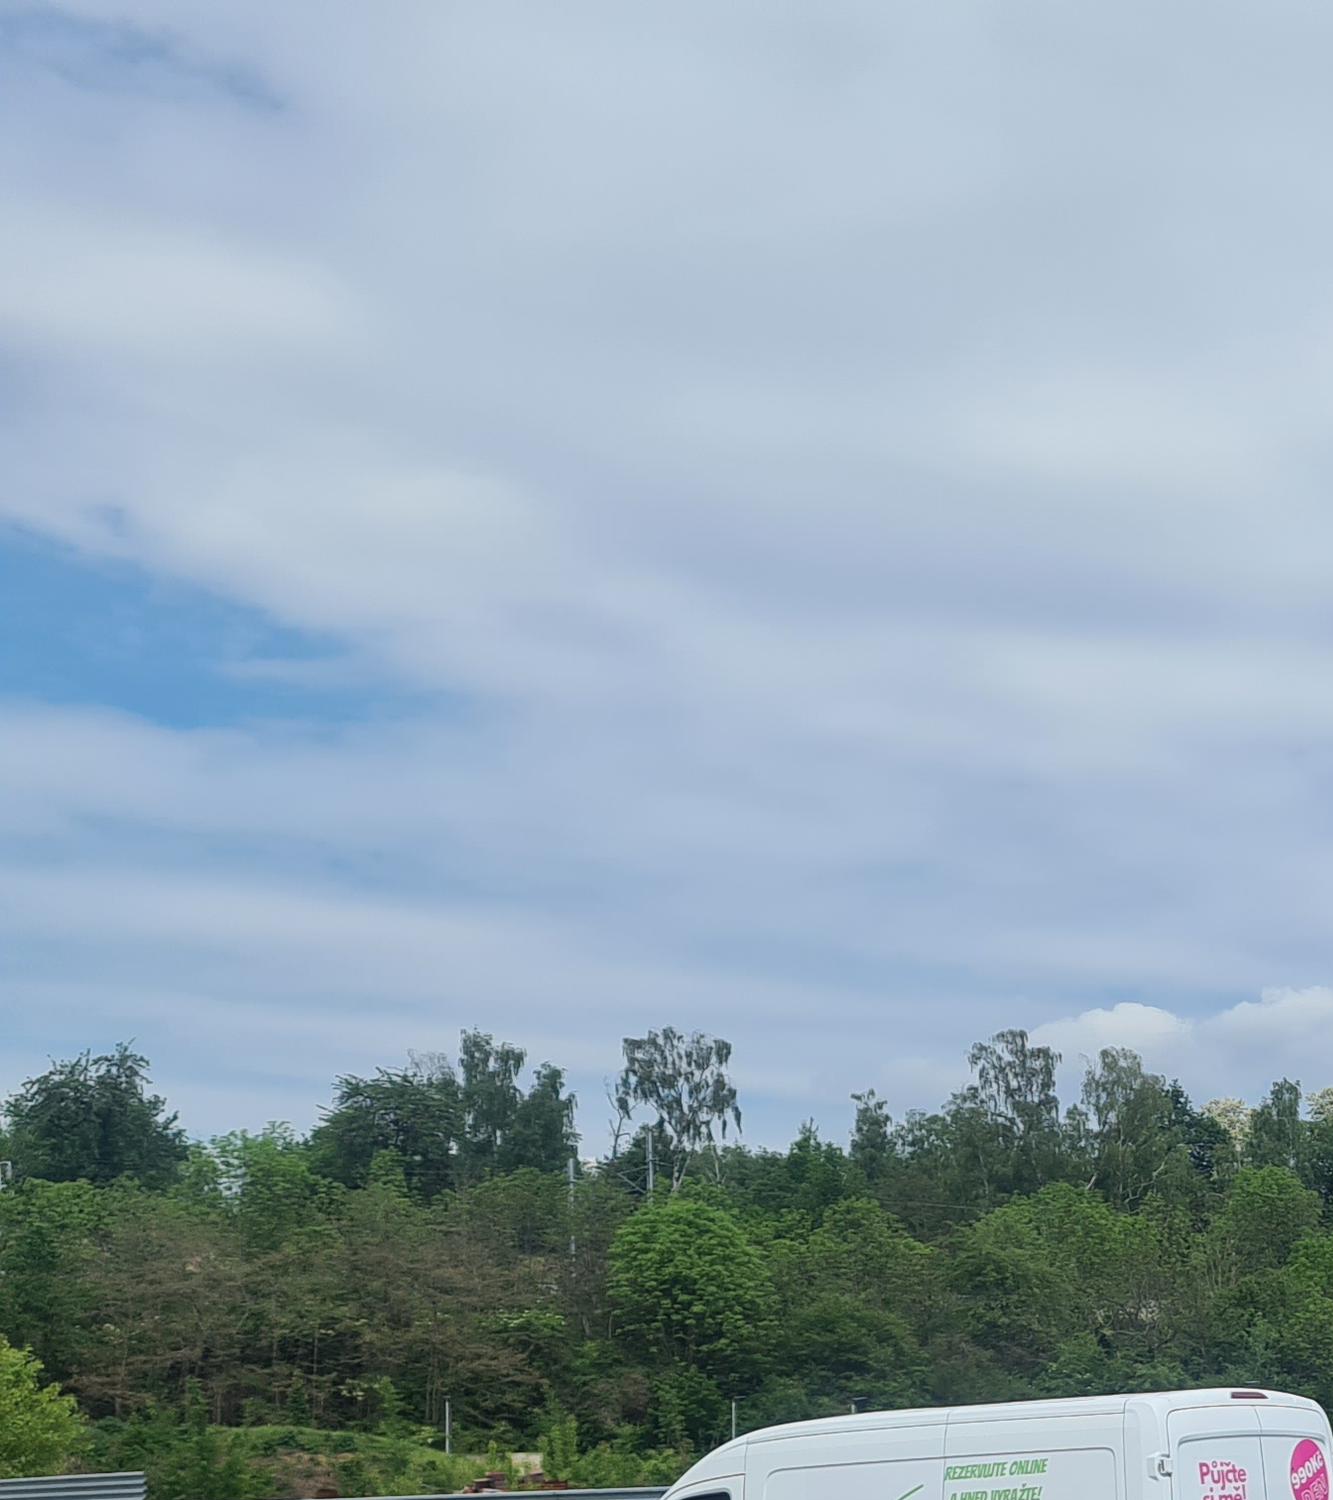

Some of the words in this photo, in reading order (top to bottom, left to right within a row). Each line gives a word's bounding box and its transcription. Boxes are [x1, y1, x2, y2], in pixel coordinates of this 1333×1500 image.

[944, 1462, 1008, 1481] REZERVUJTE
[1009, 1458, 1049, 1477] ONLINE
[1198, 1460, 1247, 1490] Půjčte
